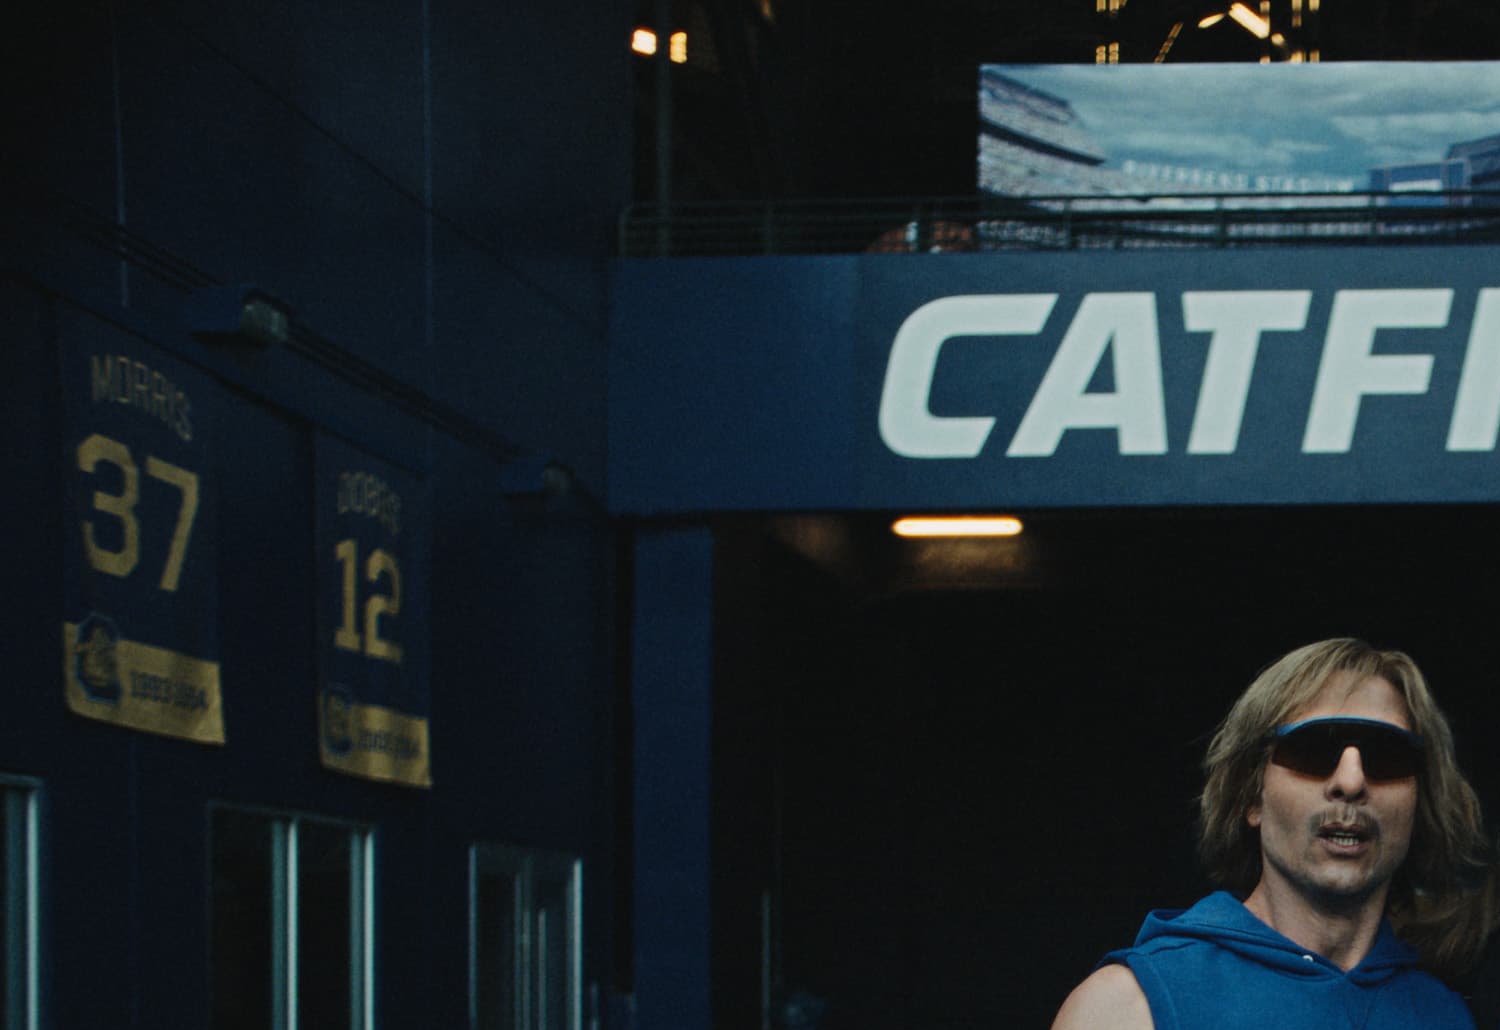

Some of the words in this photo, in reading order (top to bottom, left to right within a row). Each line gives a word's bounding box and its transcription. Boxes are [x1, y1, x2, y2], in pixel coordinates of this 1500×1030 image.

[90, 352, 193, 442] MORRIS
[76, 432, 199, 593] 37
[333, 537, 403, 664] 12
